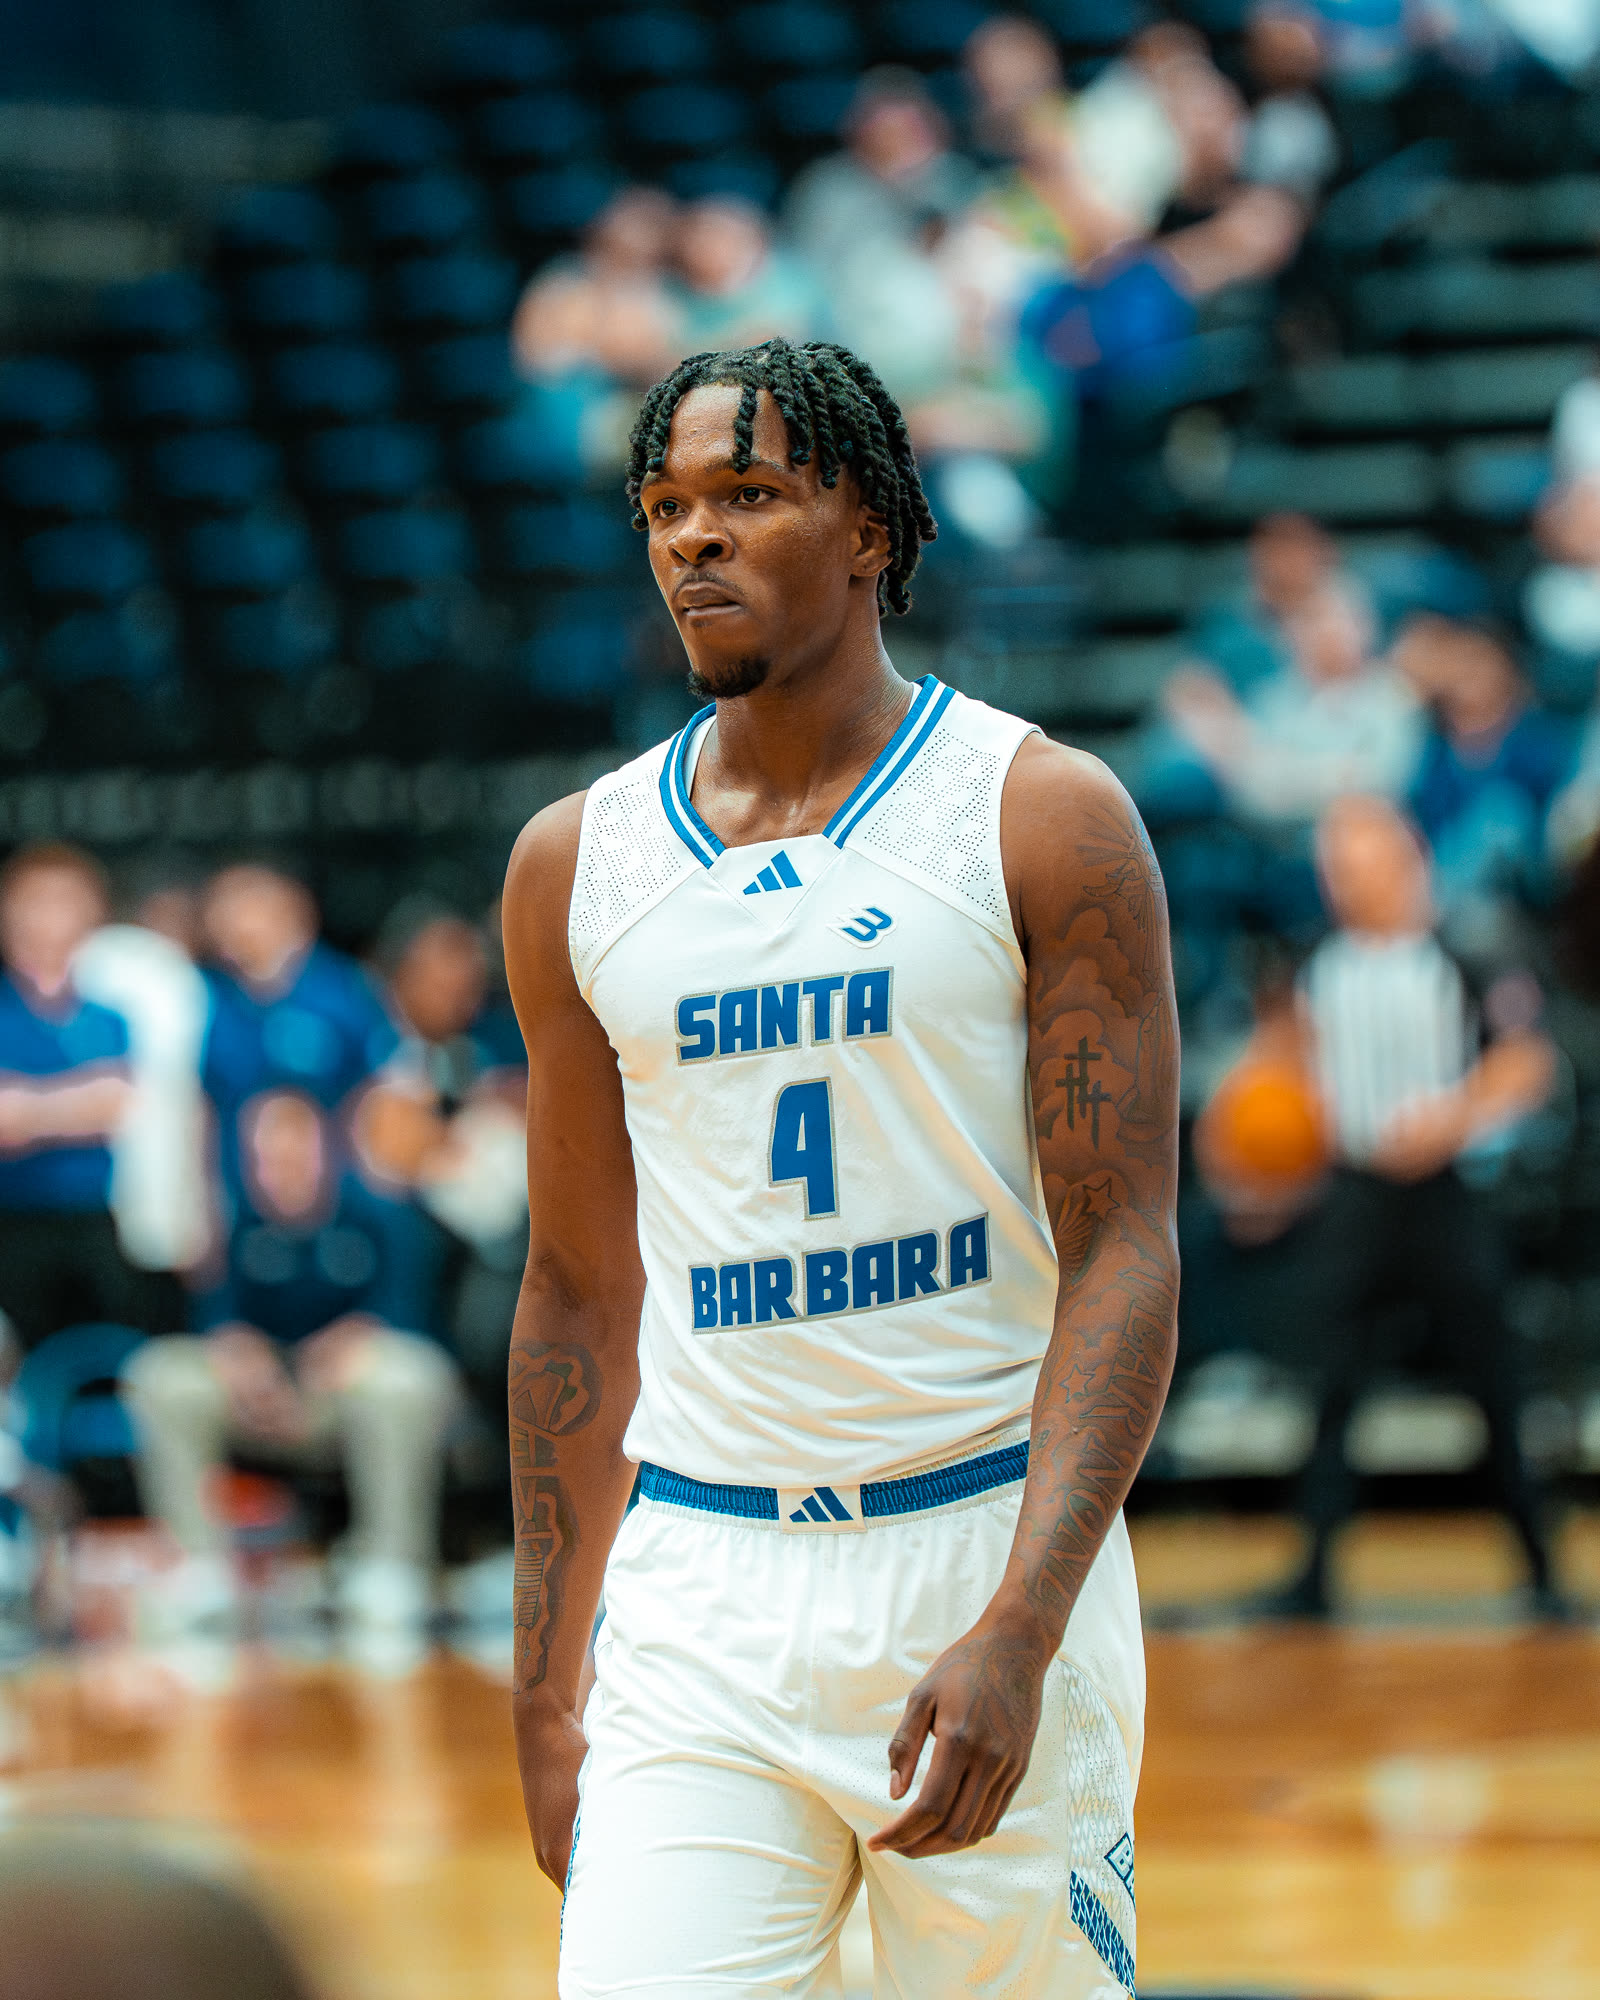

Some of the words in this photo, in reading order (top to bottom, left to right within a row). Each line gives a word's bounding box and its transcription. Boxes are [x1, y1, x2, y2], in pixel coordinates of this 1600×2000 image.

[675, 966, 894, 1065] SANTA
[768, 1076, 840, 1220] 4
[689, 1212, 992, 1334] BARBARA
